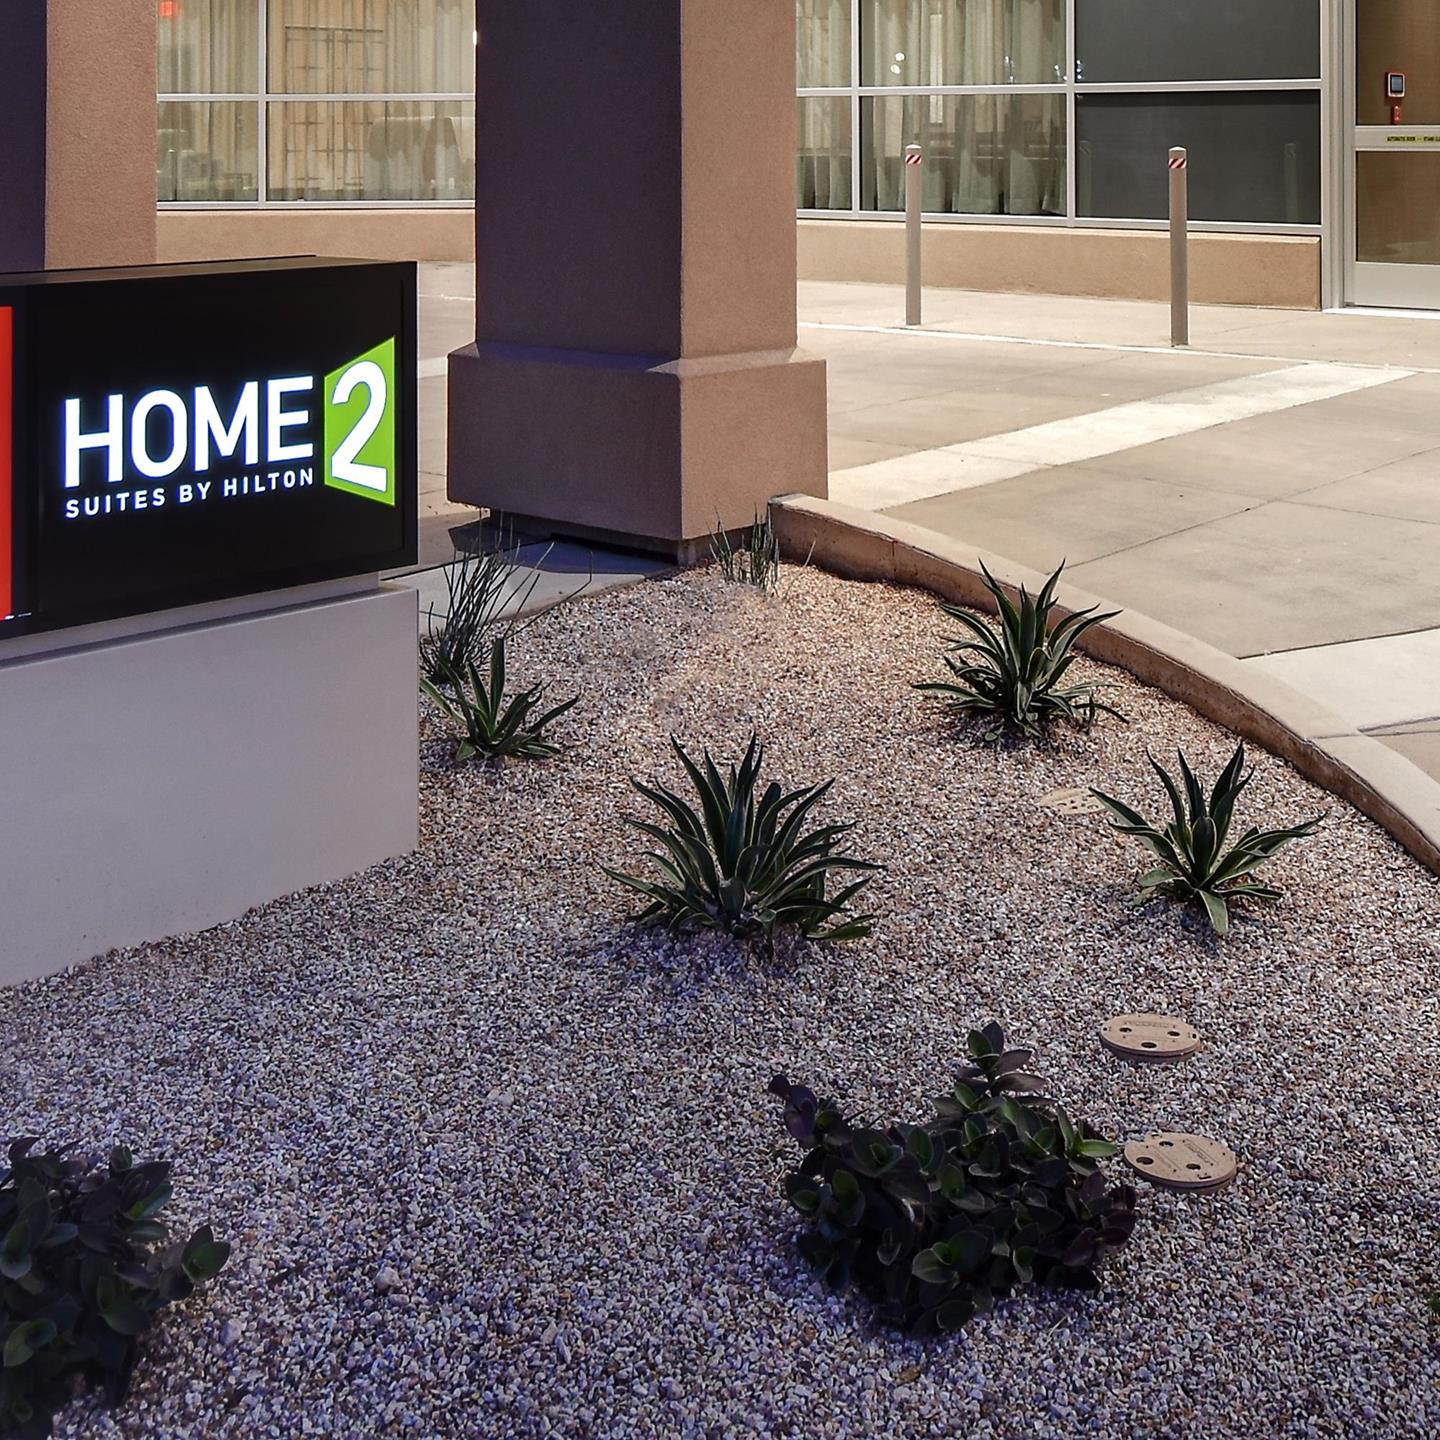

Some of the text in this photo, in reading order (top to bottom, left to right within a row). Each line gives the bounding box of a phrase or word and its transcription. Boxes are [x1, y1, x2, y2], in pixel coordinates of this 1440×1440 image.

[65, 467, 314, 519] SUITES BY HILTON
